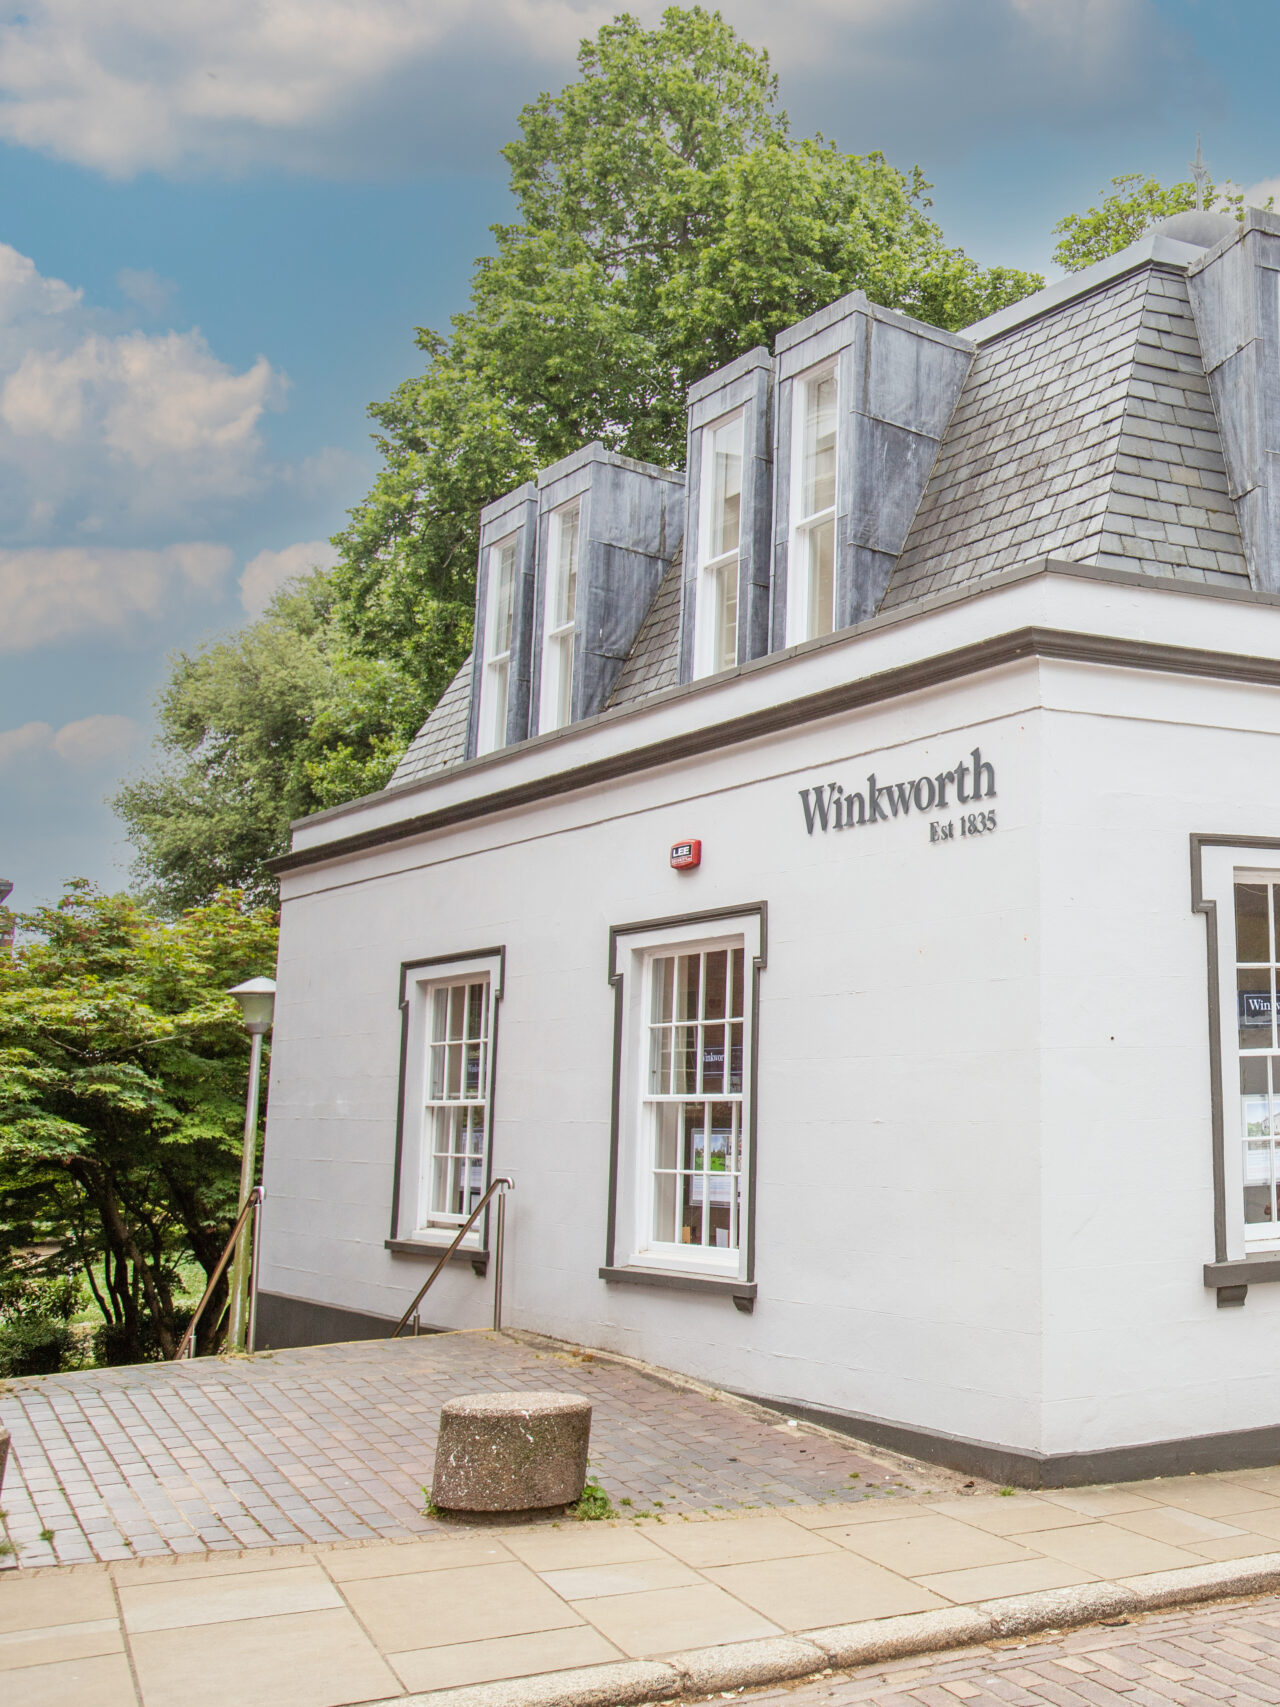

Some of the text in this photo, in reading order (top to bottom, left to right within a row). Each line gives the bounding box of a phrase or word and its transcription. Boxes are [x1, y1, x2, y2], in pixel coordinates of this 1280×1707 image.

[798, 746, 997, 836] Winkworth
[929, 809, 996, 842] Est 1835
[673, 846, 690, 857] LEE
